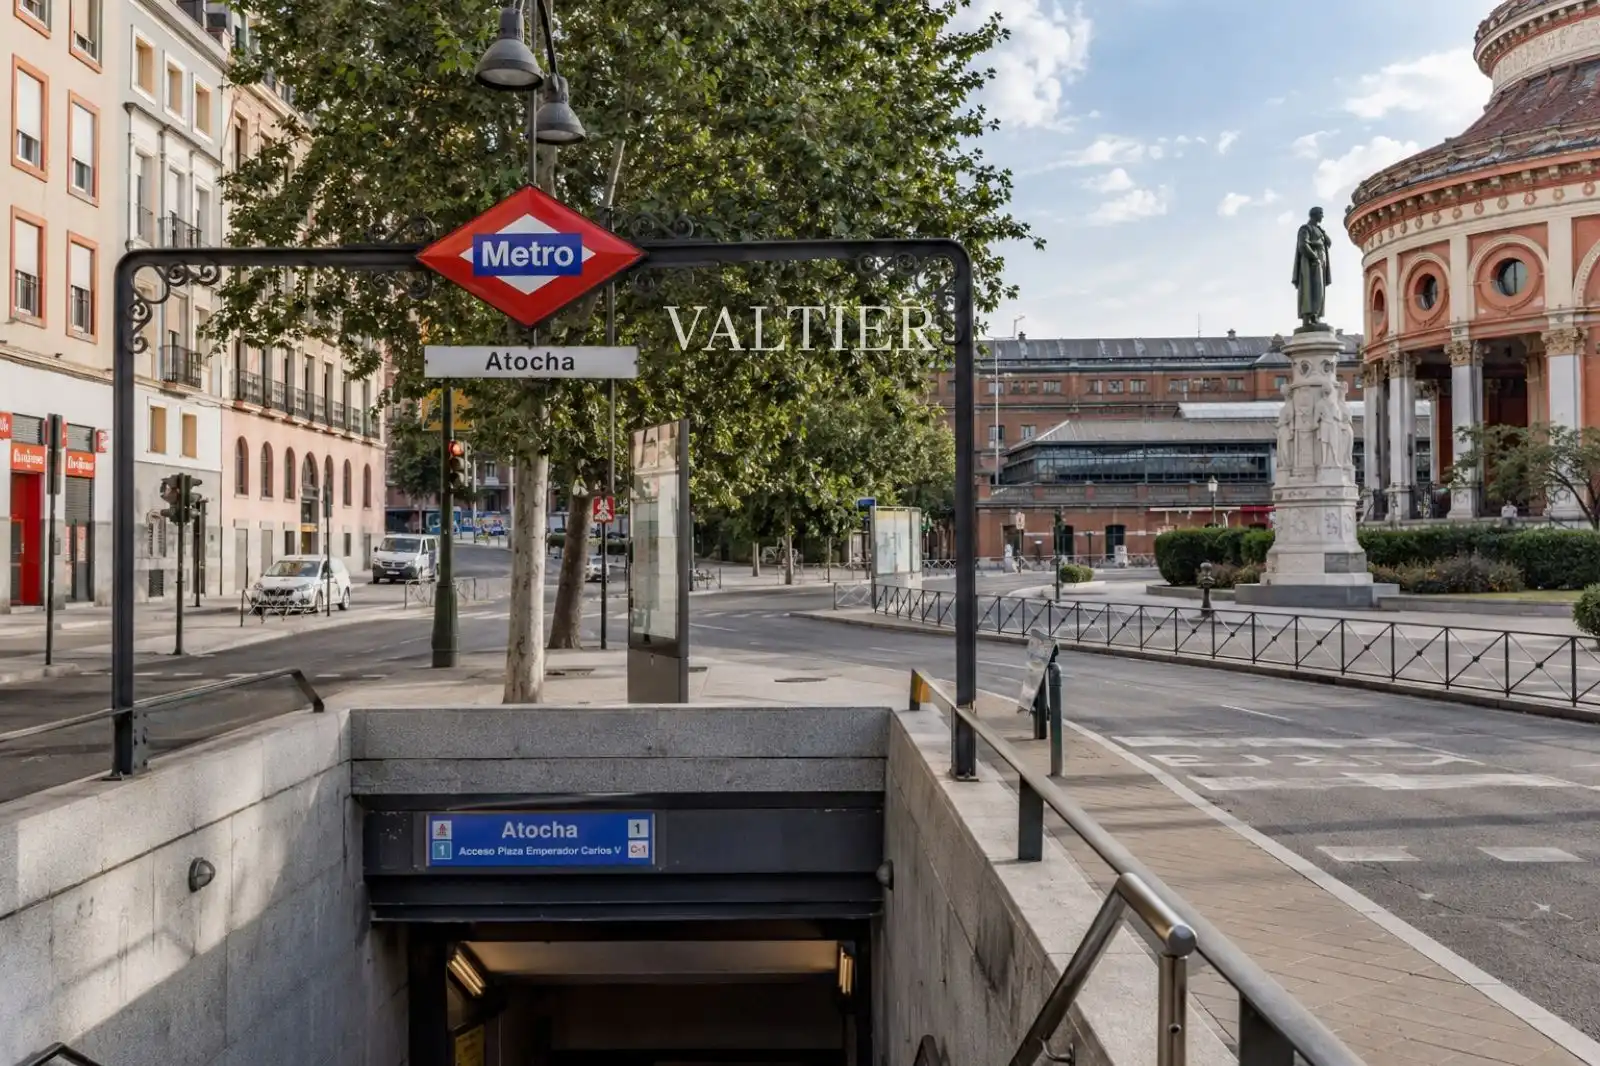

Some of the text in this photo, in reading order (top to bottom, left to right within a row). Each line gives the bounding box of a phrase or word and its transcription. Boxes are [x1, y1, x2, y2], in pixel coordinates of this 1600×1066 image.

[482, 240, 574, 267] Metro
[485, 351, 575, 371] Atocha
[501, 820, 578, 839] Atocha
[634, 823, 641, 835] 1
[439, 844, 446, 856] 1
[458, 845, 622, 857] Acceso Plaza Emperador Carlos V
[630, 844, 646, 854] C-1
